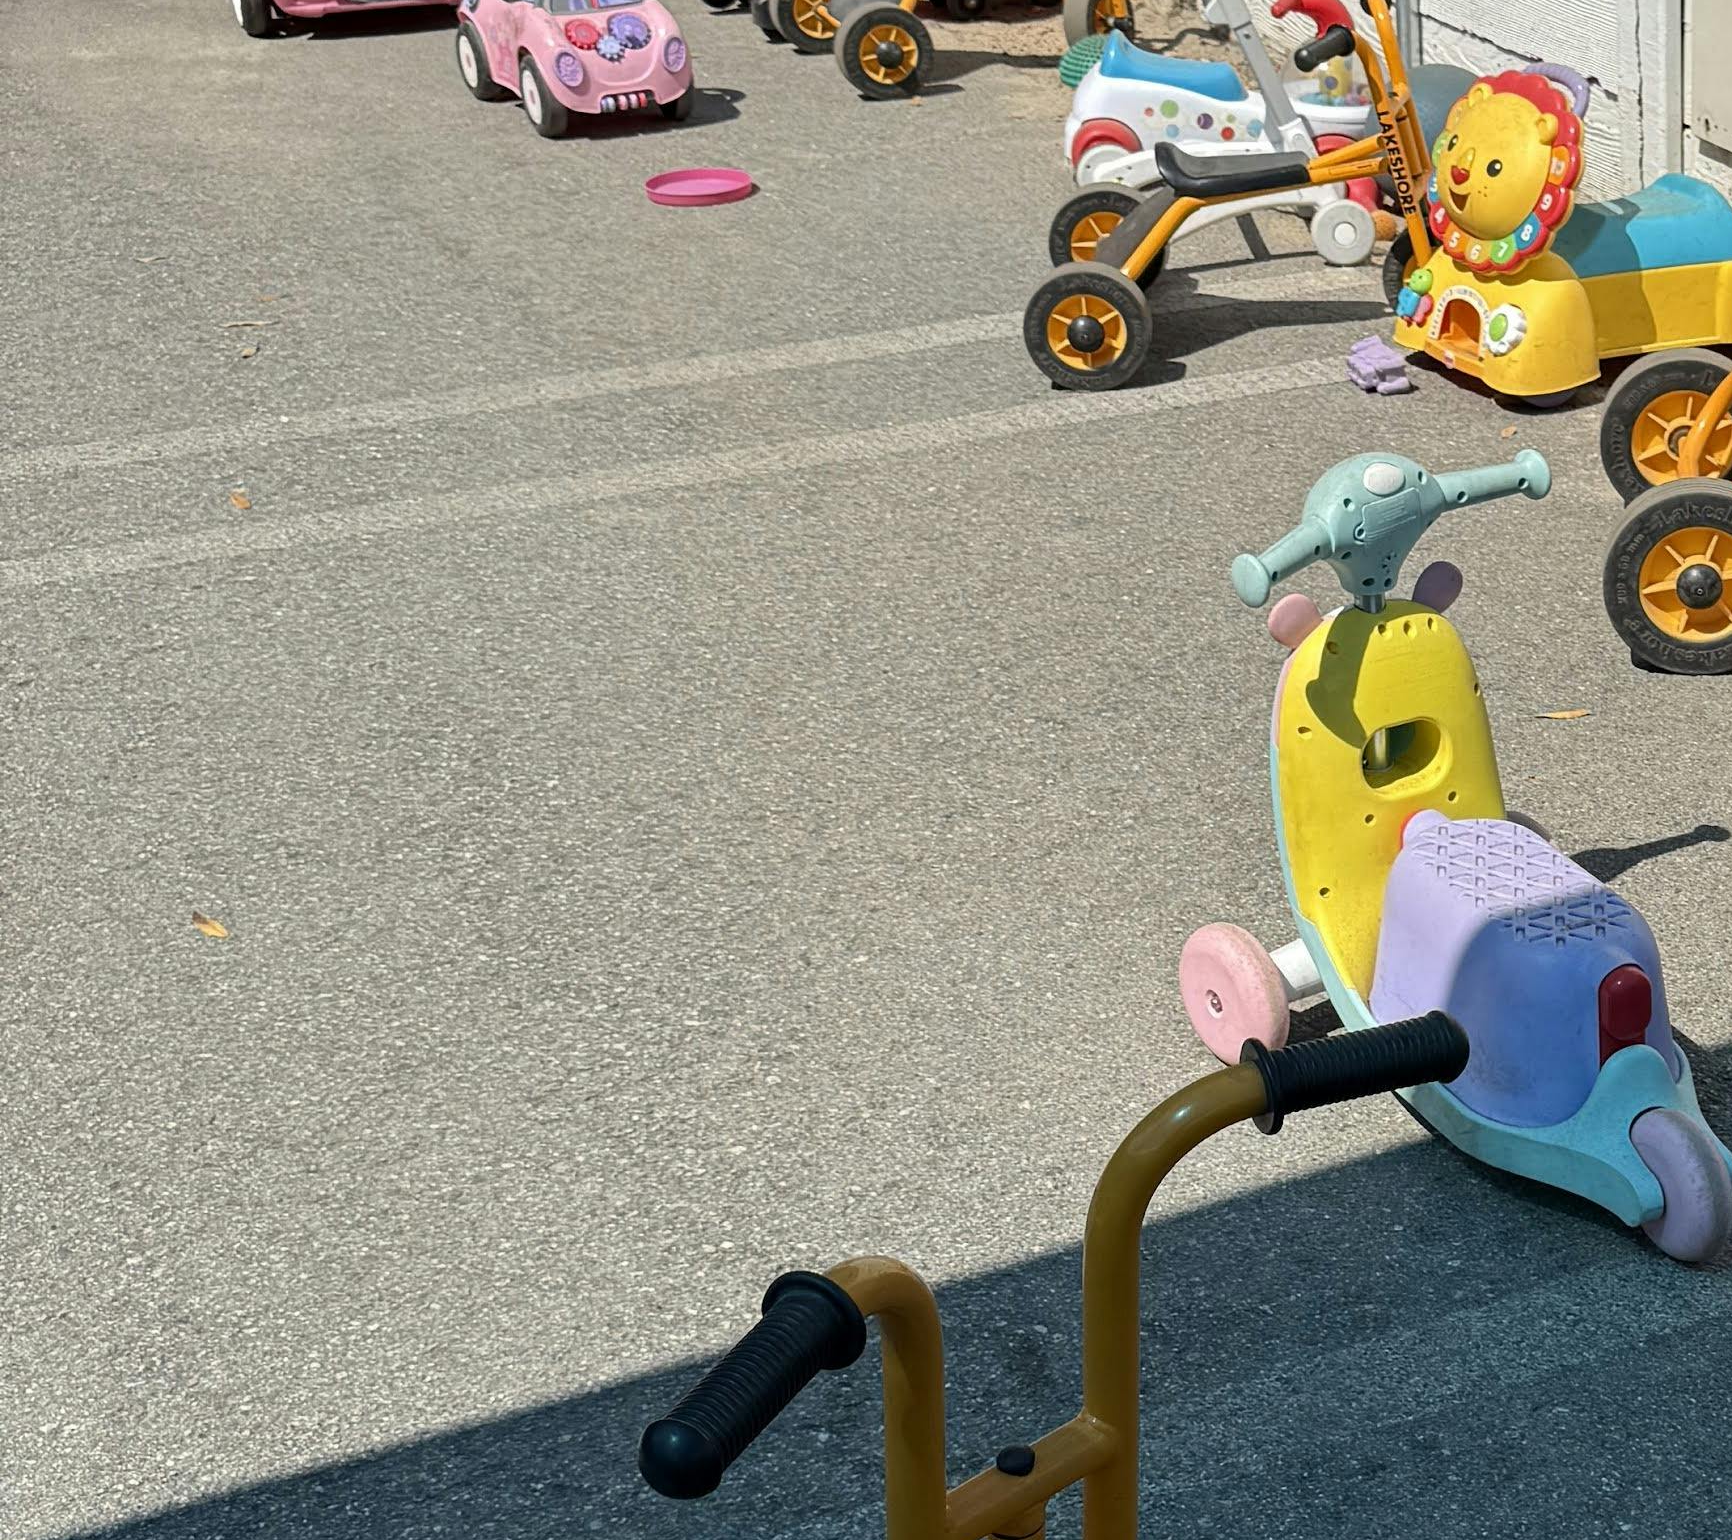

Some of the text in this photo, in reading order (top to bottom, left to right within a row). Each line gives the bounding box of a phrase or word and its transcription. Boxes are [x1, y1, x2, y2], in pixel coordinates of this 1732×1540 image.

[1376, 110, 1417, 215] LAKESHORE
[1540, 193, 1553, 211] 9
[1448, 231, 1461, 249] 5
[1520, 223, 1534, 241] 8
[1469, 243, 1482, 260] 6
[1497, 241, 1509, 258] 7
